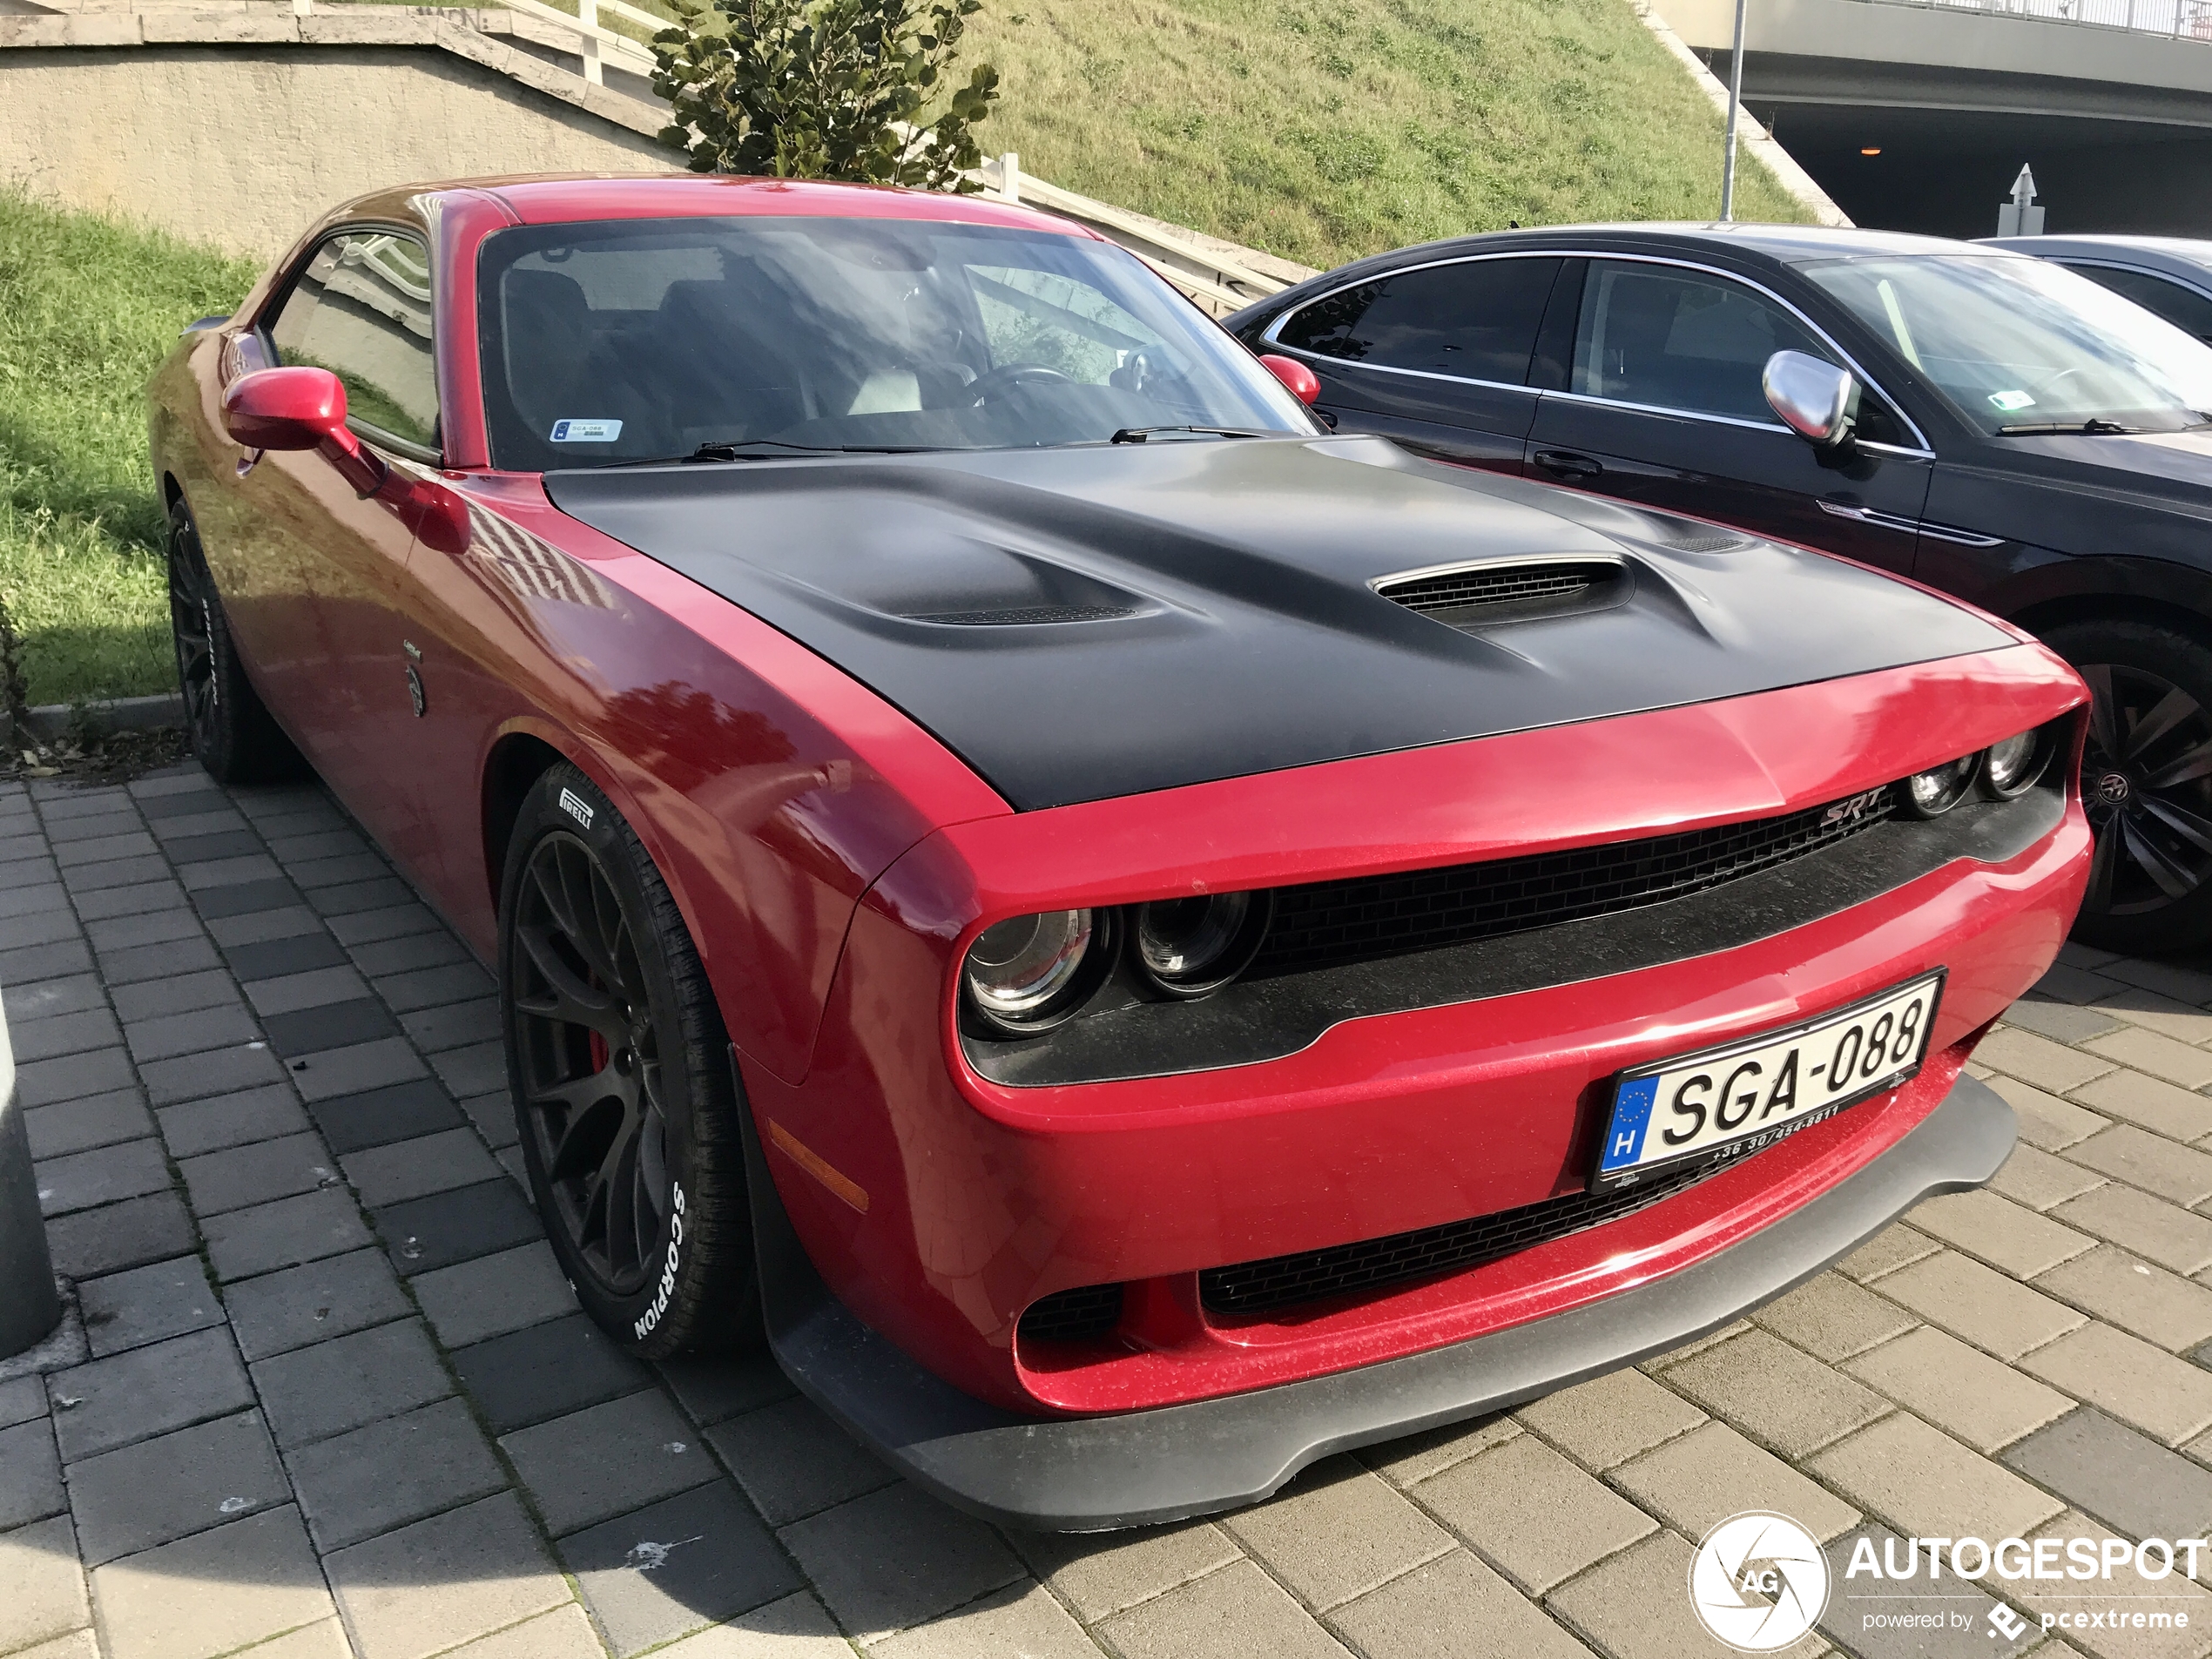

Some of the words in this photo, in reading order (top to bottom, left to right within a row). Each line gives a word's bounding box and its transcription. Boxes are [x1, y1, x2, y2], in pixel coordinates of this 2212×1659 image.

[559, 787, 594, 830] PIRELLI
[1819, 785, 1887, 827] SRT
[1663, 997, 1923, 1147] SGA-088
[1613, 1129, 1636, 1157] H
[1713, 1143, 1742, 1160] +36
[634, 1181, 685, 1340] SCORPION
